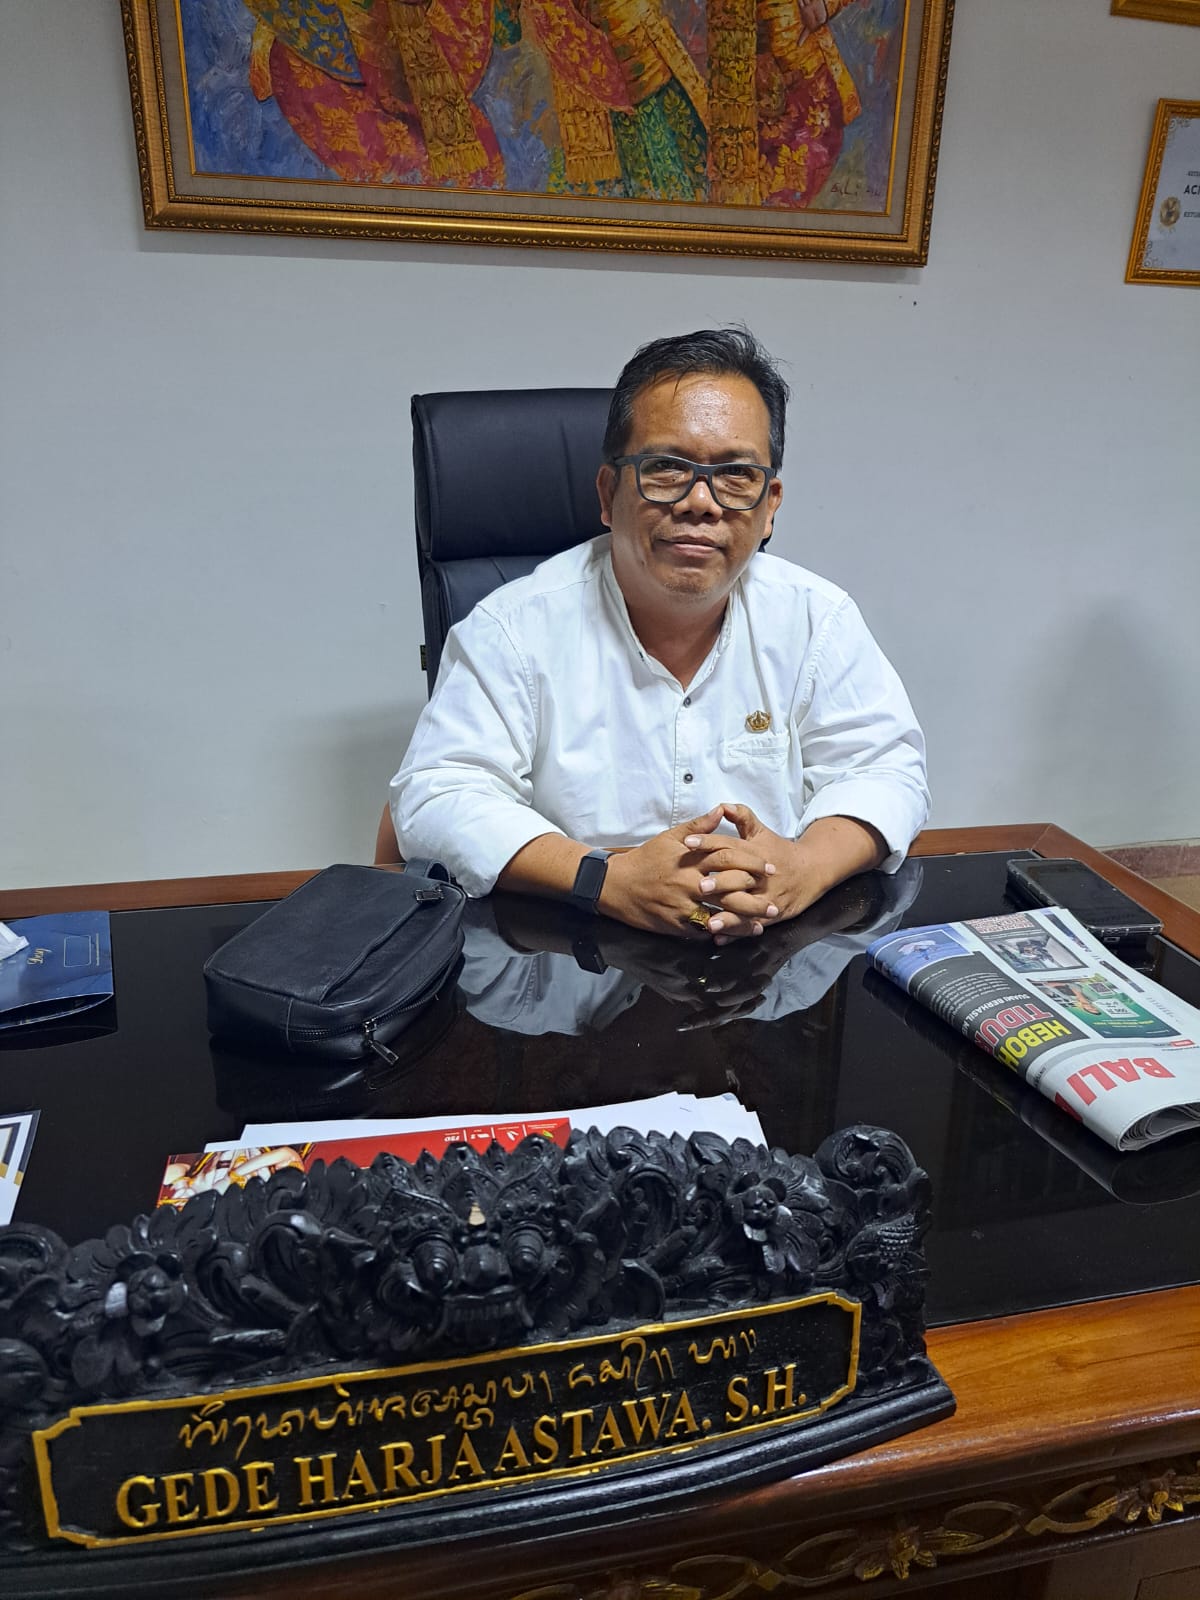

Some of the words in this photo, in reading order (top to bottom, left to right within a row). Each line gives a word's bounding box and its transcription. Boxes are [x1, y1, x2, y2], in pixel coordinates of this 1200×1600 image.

[966, 998, 1005, 1021] BERHASIL
[1066, 1057, 1176, 1106] BALI
[115, 1461, 281, 1529] GEDE
[293, 1431, 486, 1507] HARJA
[494, 1390, 712, 1473] ASTAWA.
[725, 1363, 808, 1423] S.H.
